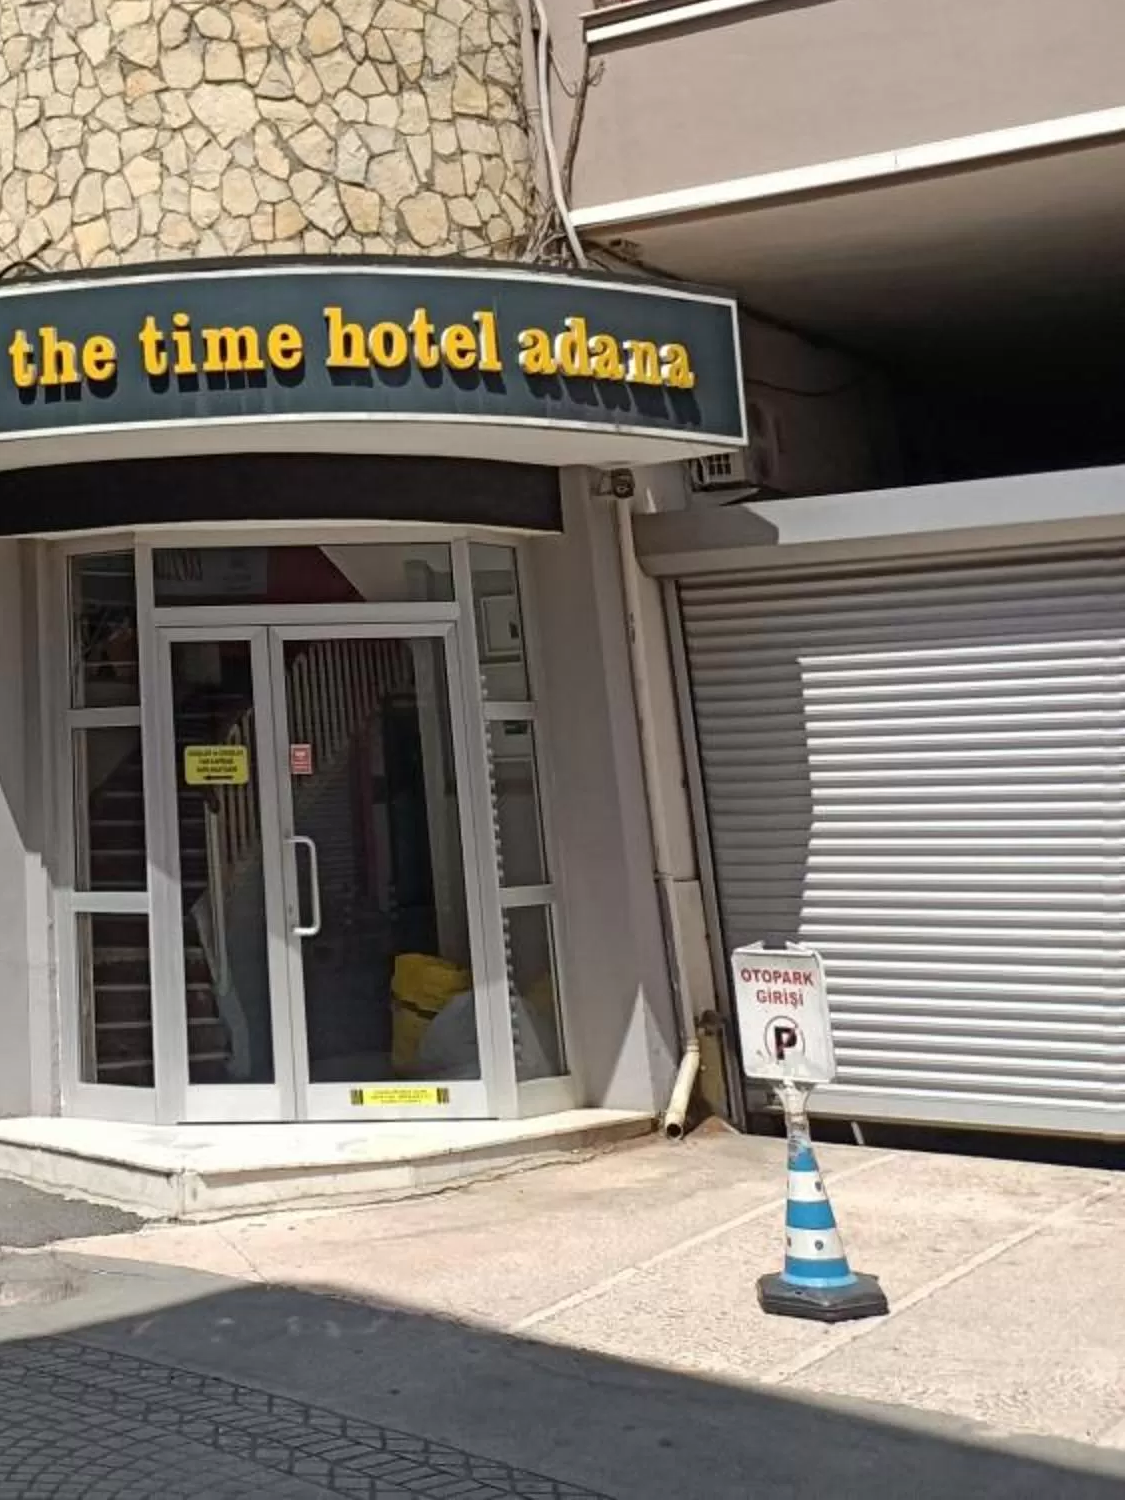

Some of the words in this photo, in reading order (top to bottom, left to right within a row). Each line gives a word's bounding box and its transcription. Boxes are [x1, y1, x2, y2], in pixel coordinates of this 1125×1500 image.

[9, 326, 116, 388] the
[139, 313, 303, 376] time
[324, 306, 502, 371] hotel
[518, 317, 695, 389] adana
[740, 967, 814, 986] OTOPARK
[774, 1026, 797, 1060] P
